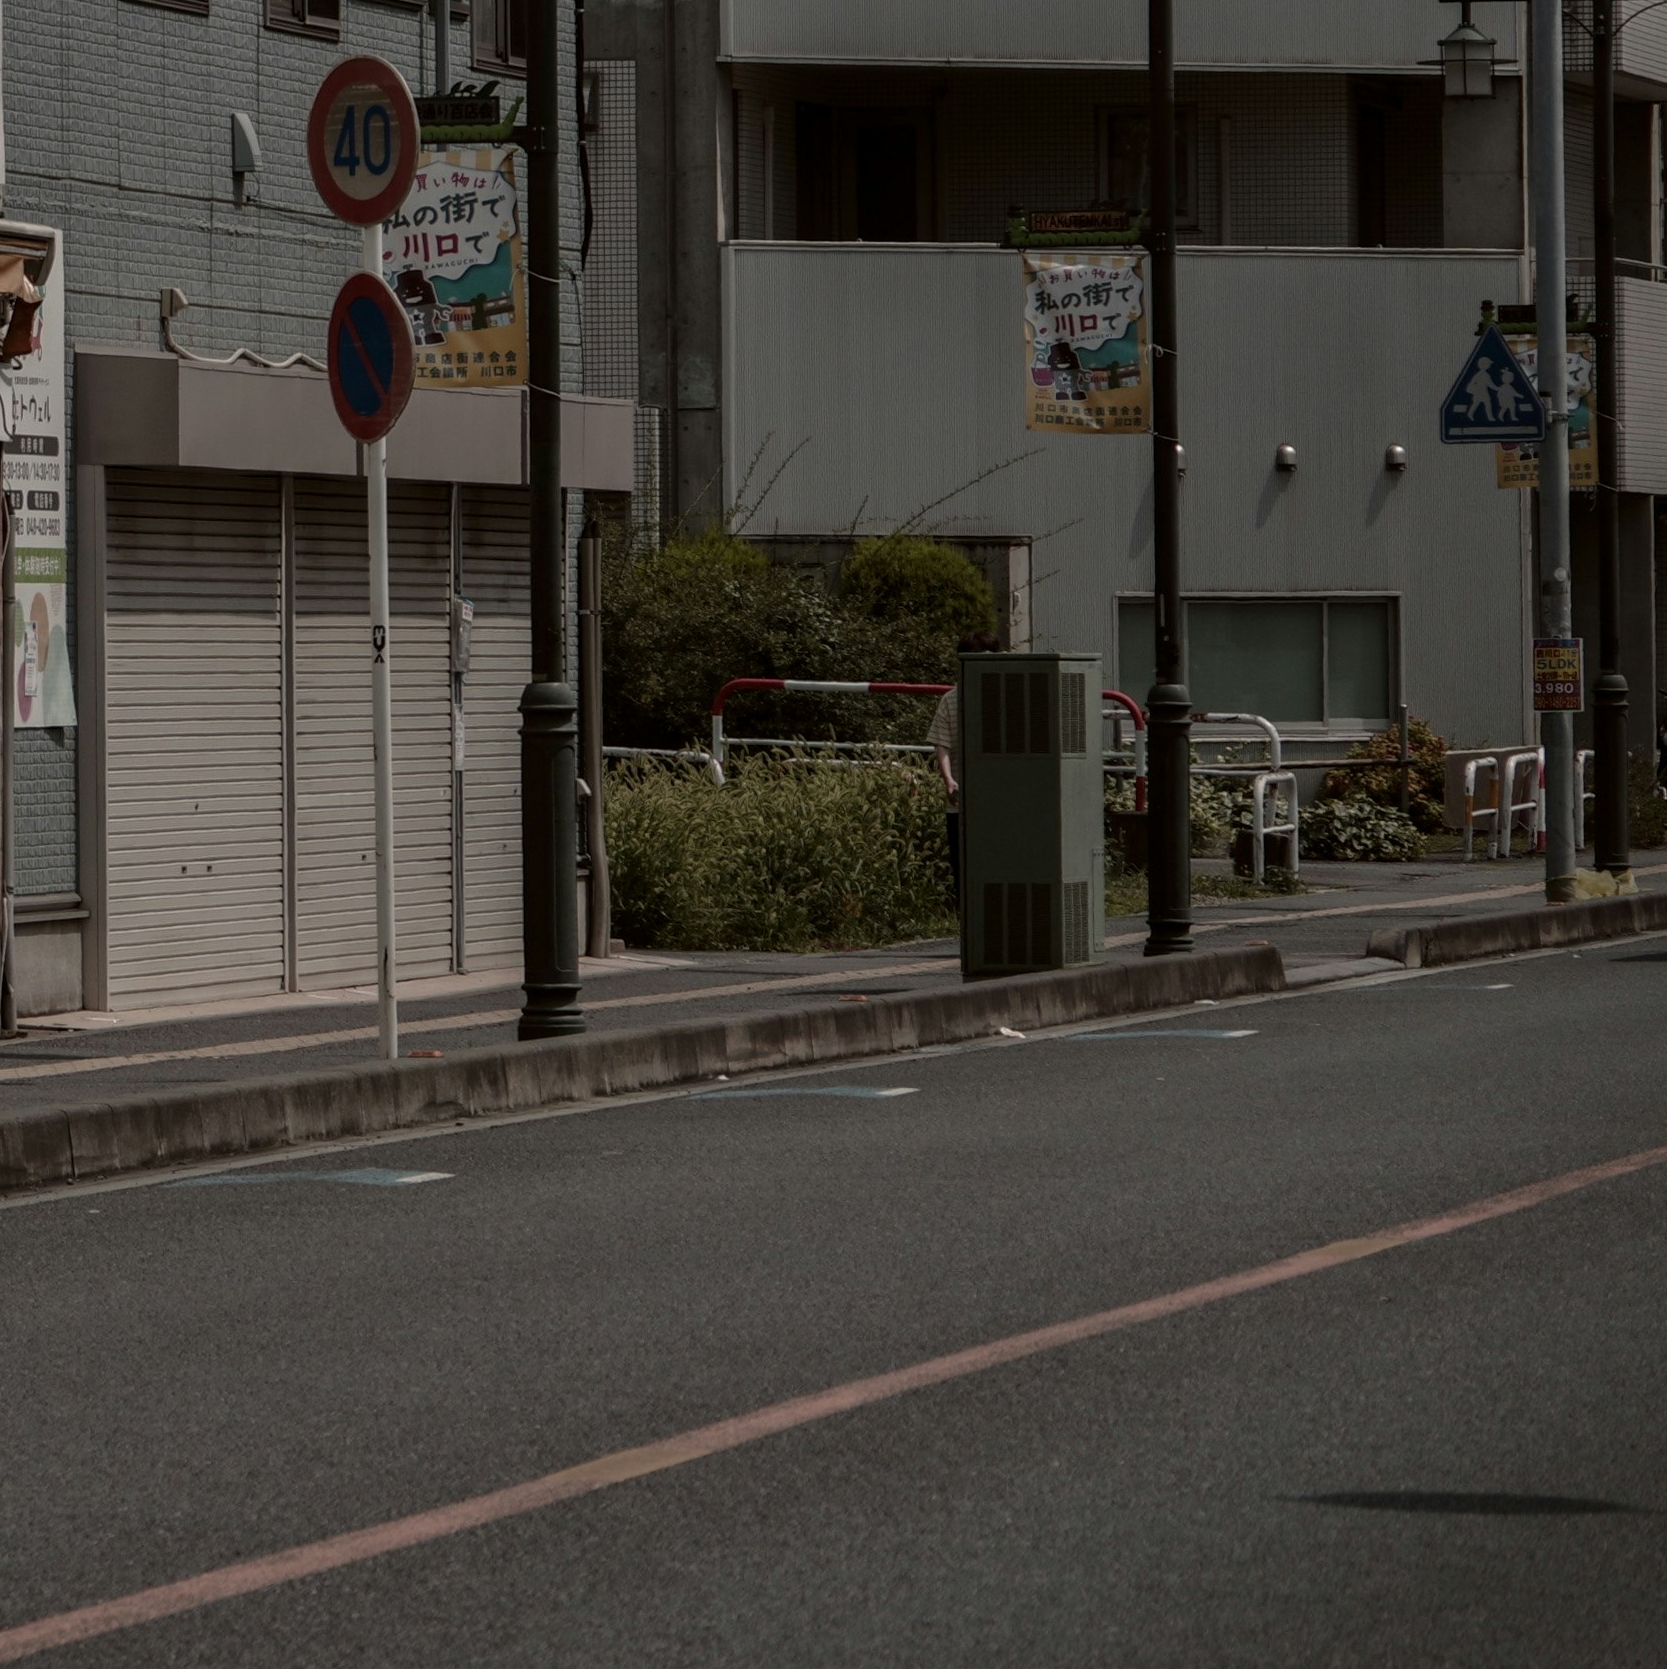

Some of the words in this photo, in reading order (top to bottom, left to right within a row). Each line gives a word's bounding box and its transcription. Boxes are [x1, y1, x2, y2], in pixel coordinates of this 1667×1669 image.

[334, 104, 391, 177] 40
[403, 231, 490, 263] 川口で
[424, 258, 480, 271] KAWAGUCHI
[1049, 268, 1121, 285] お買い物は
[1034, 281, 1140, 316] 私の街で
[1054, 312, 1123, 337] 川口で
[481, 366, 518, 378] 川口市
[1536, 658, 1577, 670] 5LDK
[1534, 682, 1575, 695] 3.980
